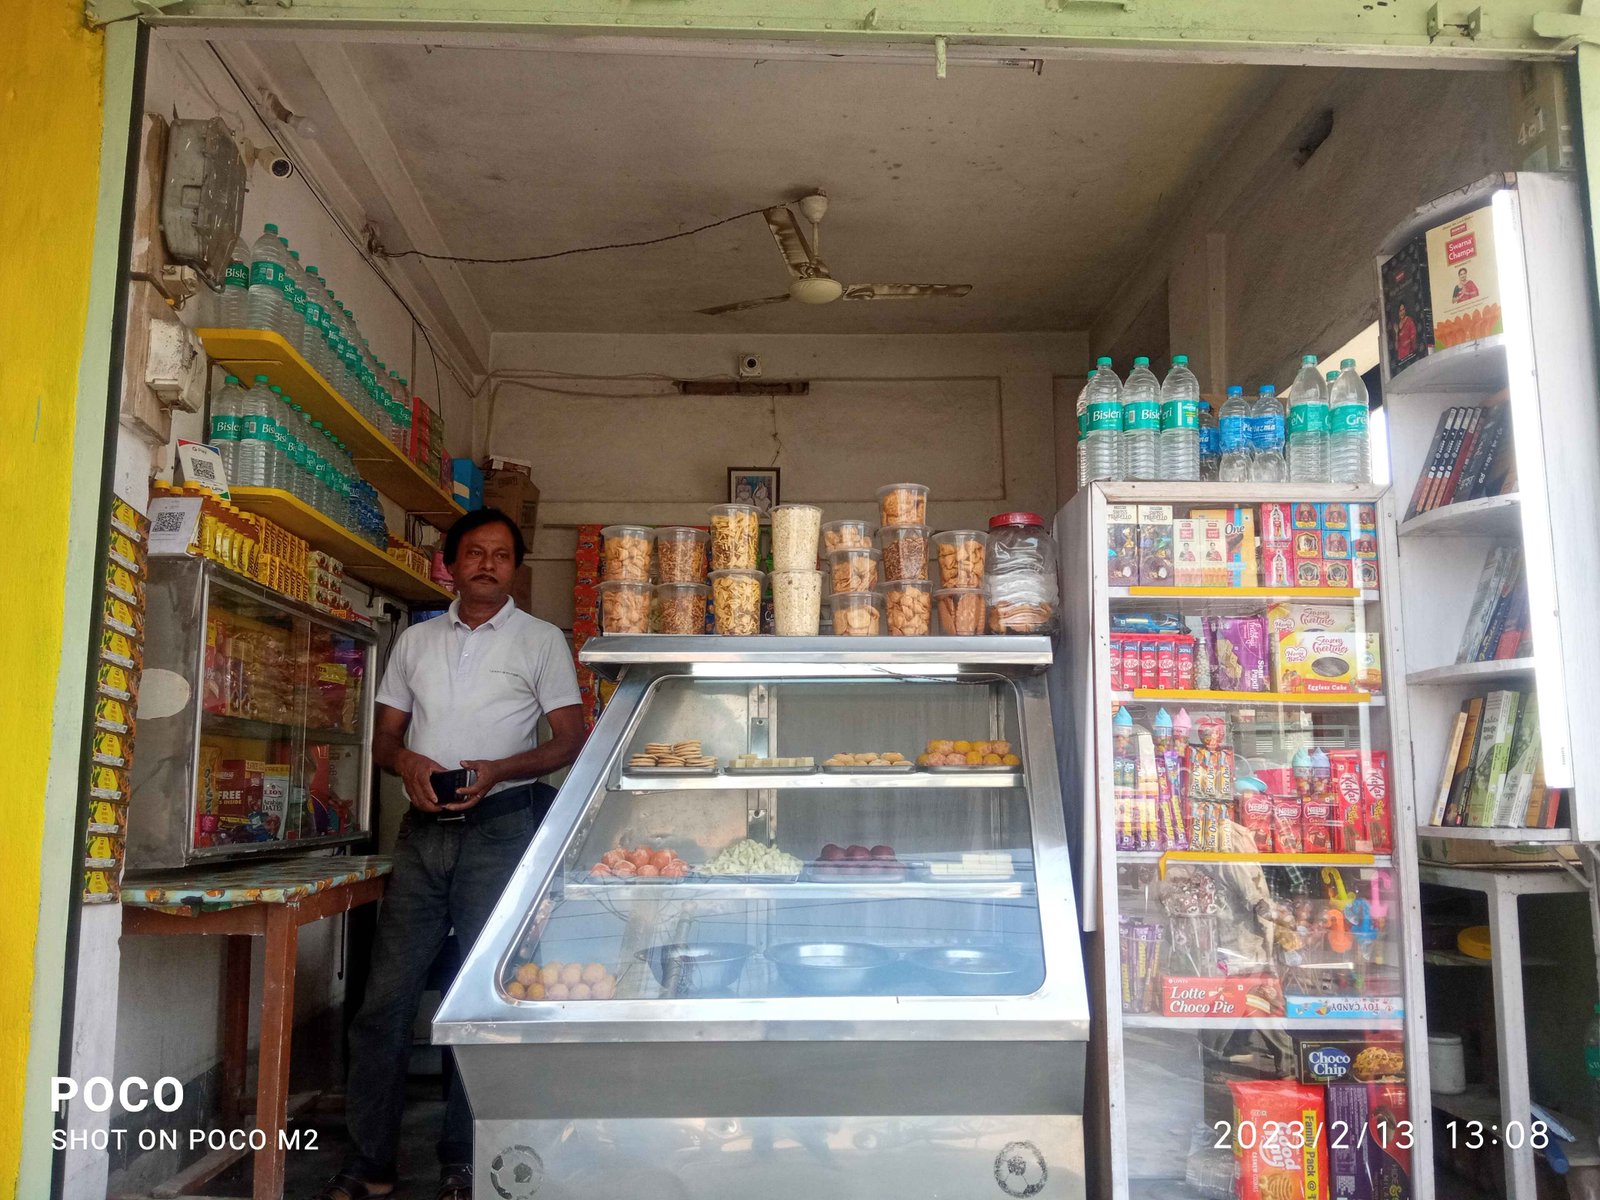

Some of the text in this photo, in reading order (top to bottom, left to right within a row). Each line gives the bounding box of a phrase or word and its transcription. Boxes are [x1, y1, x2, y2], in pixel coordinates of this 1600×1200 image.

[1449, 239, 1472, 252] Swarna
[1449, 247, 1474, 260] Champa
[1341, 776, 1360, 801] KitKat
[1366, 772, 1385, 797] KitKat
[1170, 986, 1206, 999] Lotte
[1170, 1000, 1235, 1013] Choco Pie
[1332, 1003, 1380, 1011] TOY CANDY
[1308, 1051, 1351, 1064] Choco
[1313, 1063, 1347, 1077] Chip
[1304, 1115, 1316, 1149] Family
[1307, 1151, 1316, 1177] Pack
